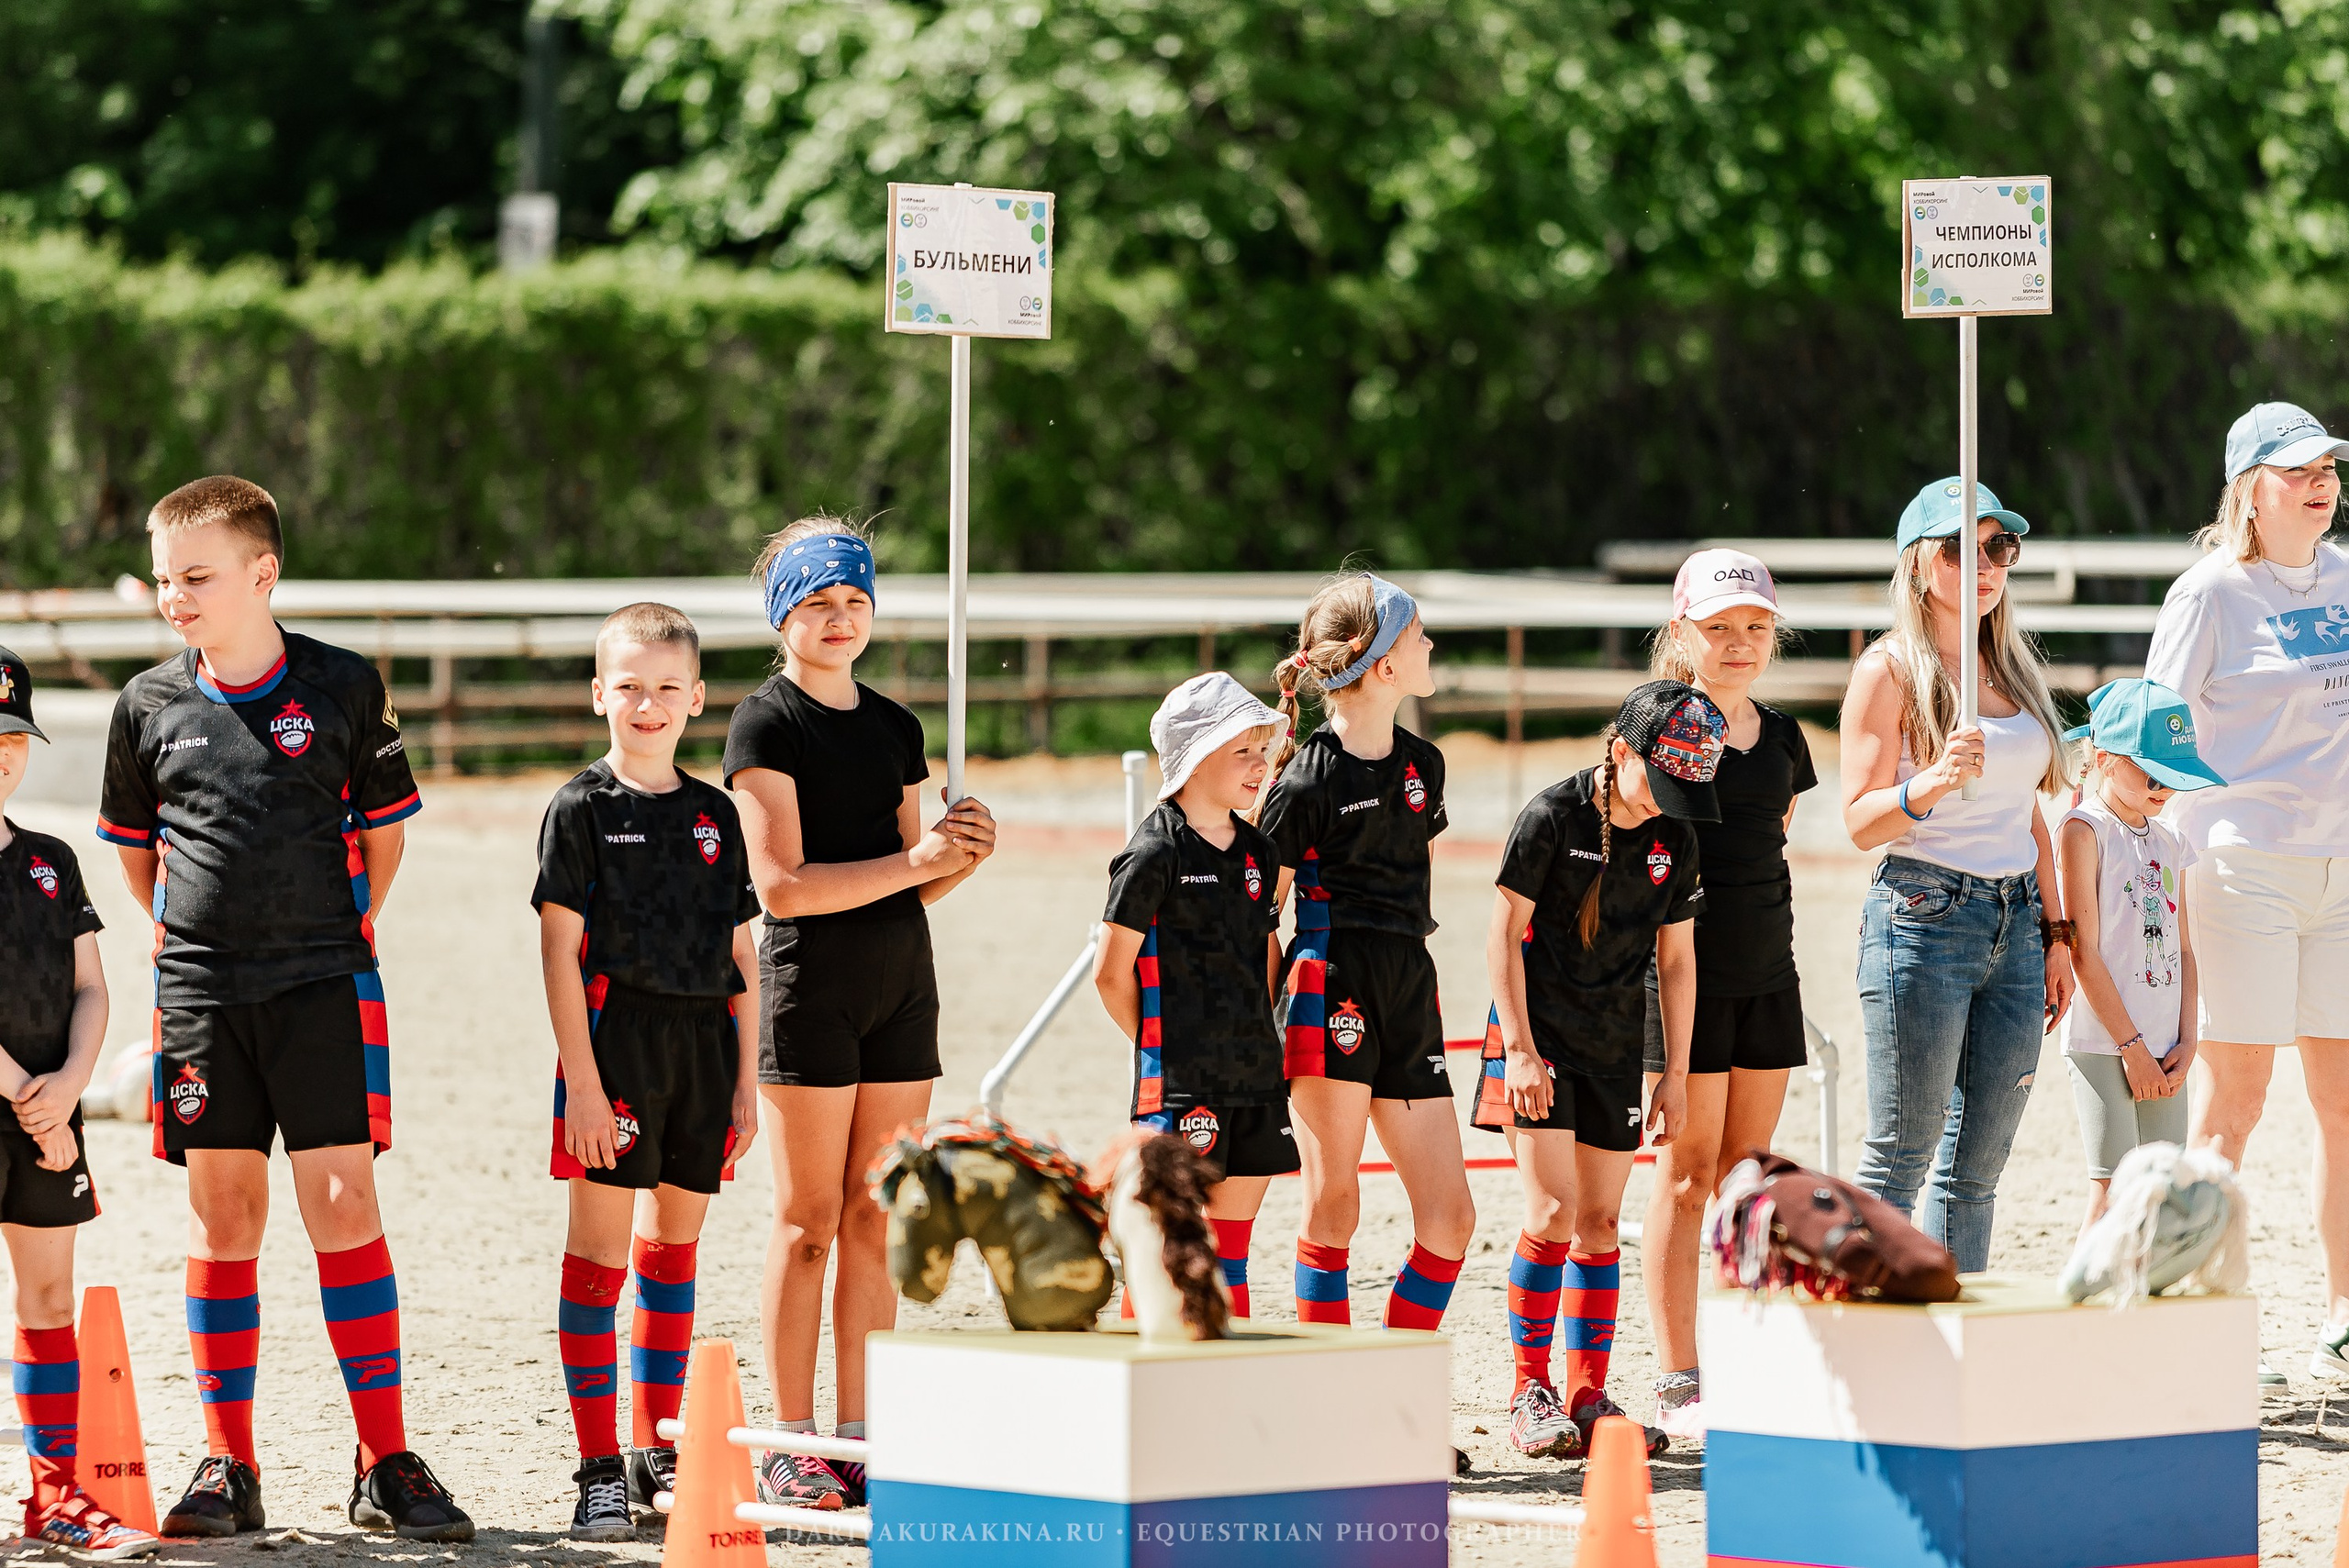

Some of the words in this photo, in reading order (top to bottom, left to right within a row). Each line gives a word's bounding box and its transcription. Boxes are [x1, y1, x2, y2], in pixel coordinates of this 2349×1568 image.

[1936, 225, 2032, 240] ЧЕМПИОНЫ
[914, 250, 1031, 274] БУЛЬМЕНИ
[1932, 251, 2037, 269] ИСПОЛКОМА
[2310, 662, 2327, 672] FIRST
[270, 717, 315, 733] ЦСКА
[168, 737, 208, 752] PATRICK
[1349, 798, 1380, 812] PATRICK
[607, 834, 646, 843] PATRICK
[693, 827, 721, 842] ЦСКА
[1647, 854, 1672, 865] ЦСКА
[29, 866, 58, 879] ЦСКА
[1329, 1016, 1365, 1033] ЦСКА
[170, 1083, 209, 1099] ЦСКА
[1179, 1117, 1220, 1131] ЦСКА
